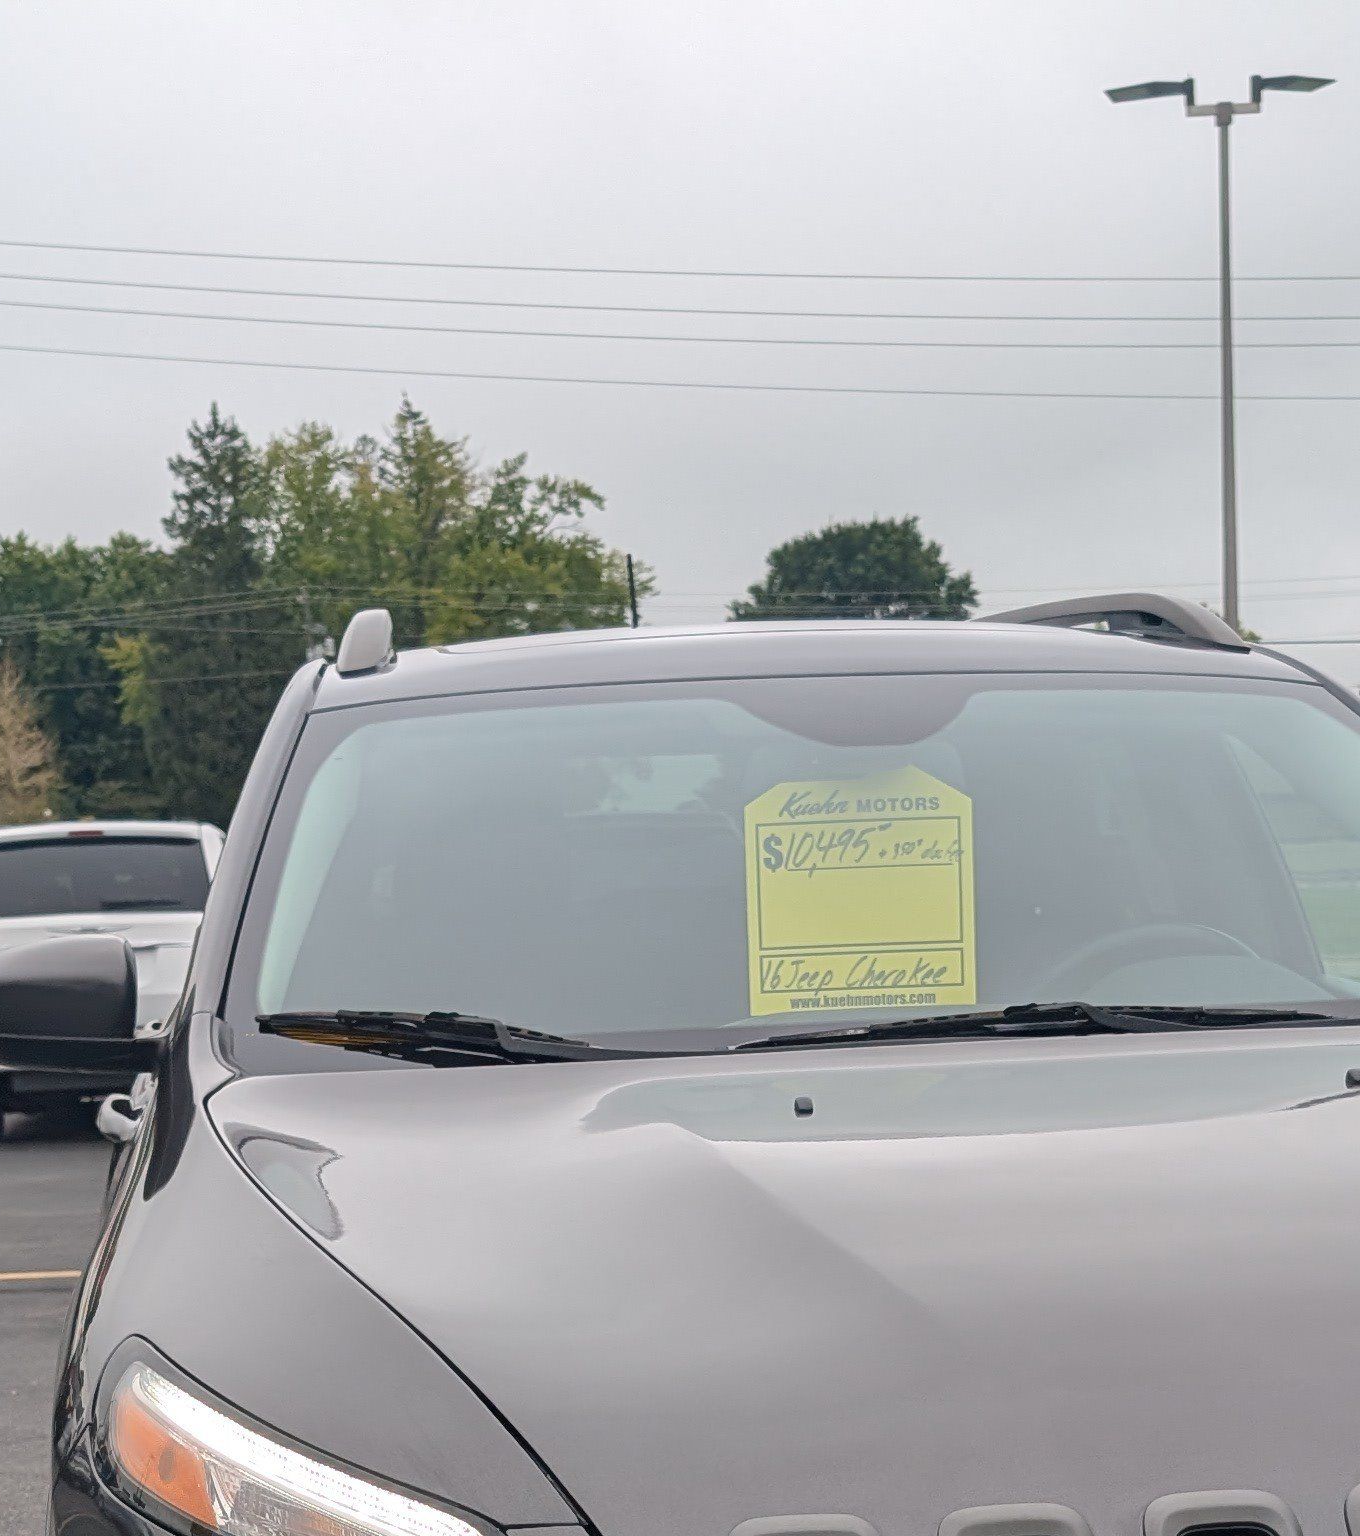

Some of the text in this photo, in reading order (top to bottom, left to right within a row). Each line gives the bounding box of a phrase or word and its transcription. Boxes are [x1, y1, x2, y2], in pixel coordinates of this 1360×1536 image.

[779, 789, 941, 819] Kuehn MOTORS
[785, 959, 834, 995] Jeep
[790, 992, 937, 1010] www.kuehnmotors.com
